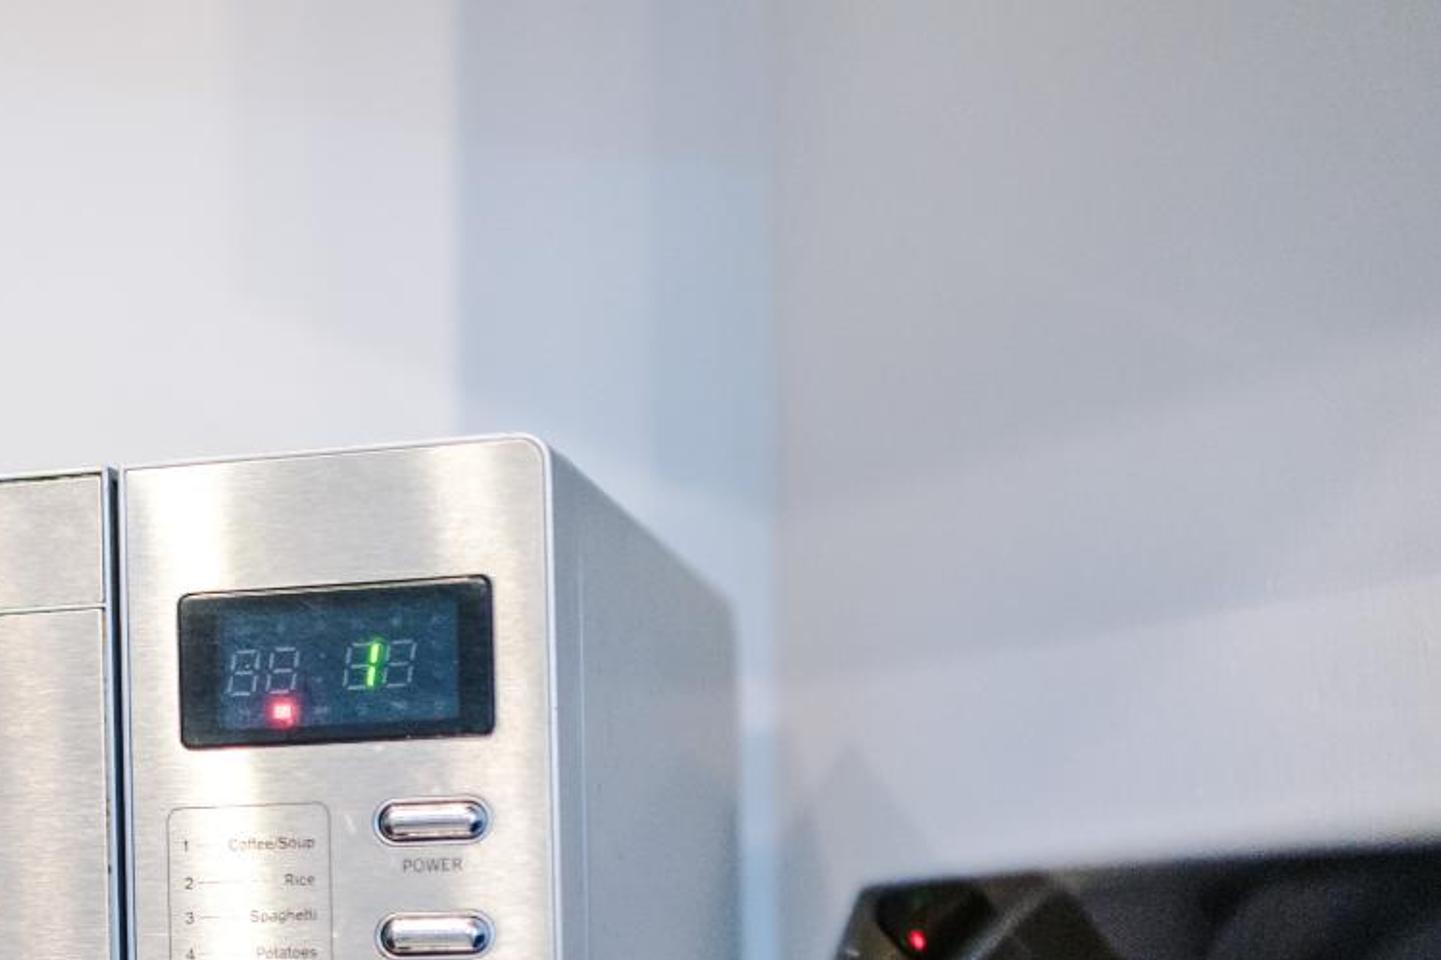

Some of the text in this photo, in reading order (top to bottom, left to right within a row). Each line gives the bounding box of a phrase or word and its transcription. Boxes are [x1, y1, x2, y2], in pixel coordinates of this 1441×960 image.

[228, 836, 316, 850] Coffee/Soup
[403, 858, 463, 873] POWER
[184, 873, 316, 890] 2 Rice
[185, 909, 318, 925] 3 Spaghetti
[186, 946, 318, 960] 4 Potatoes
